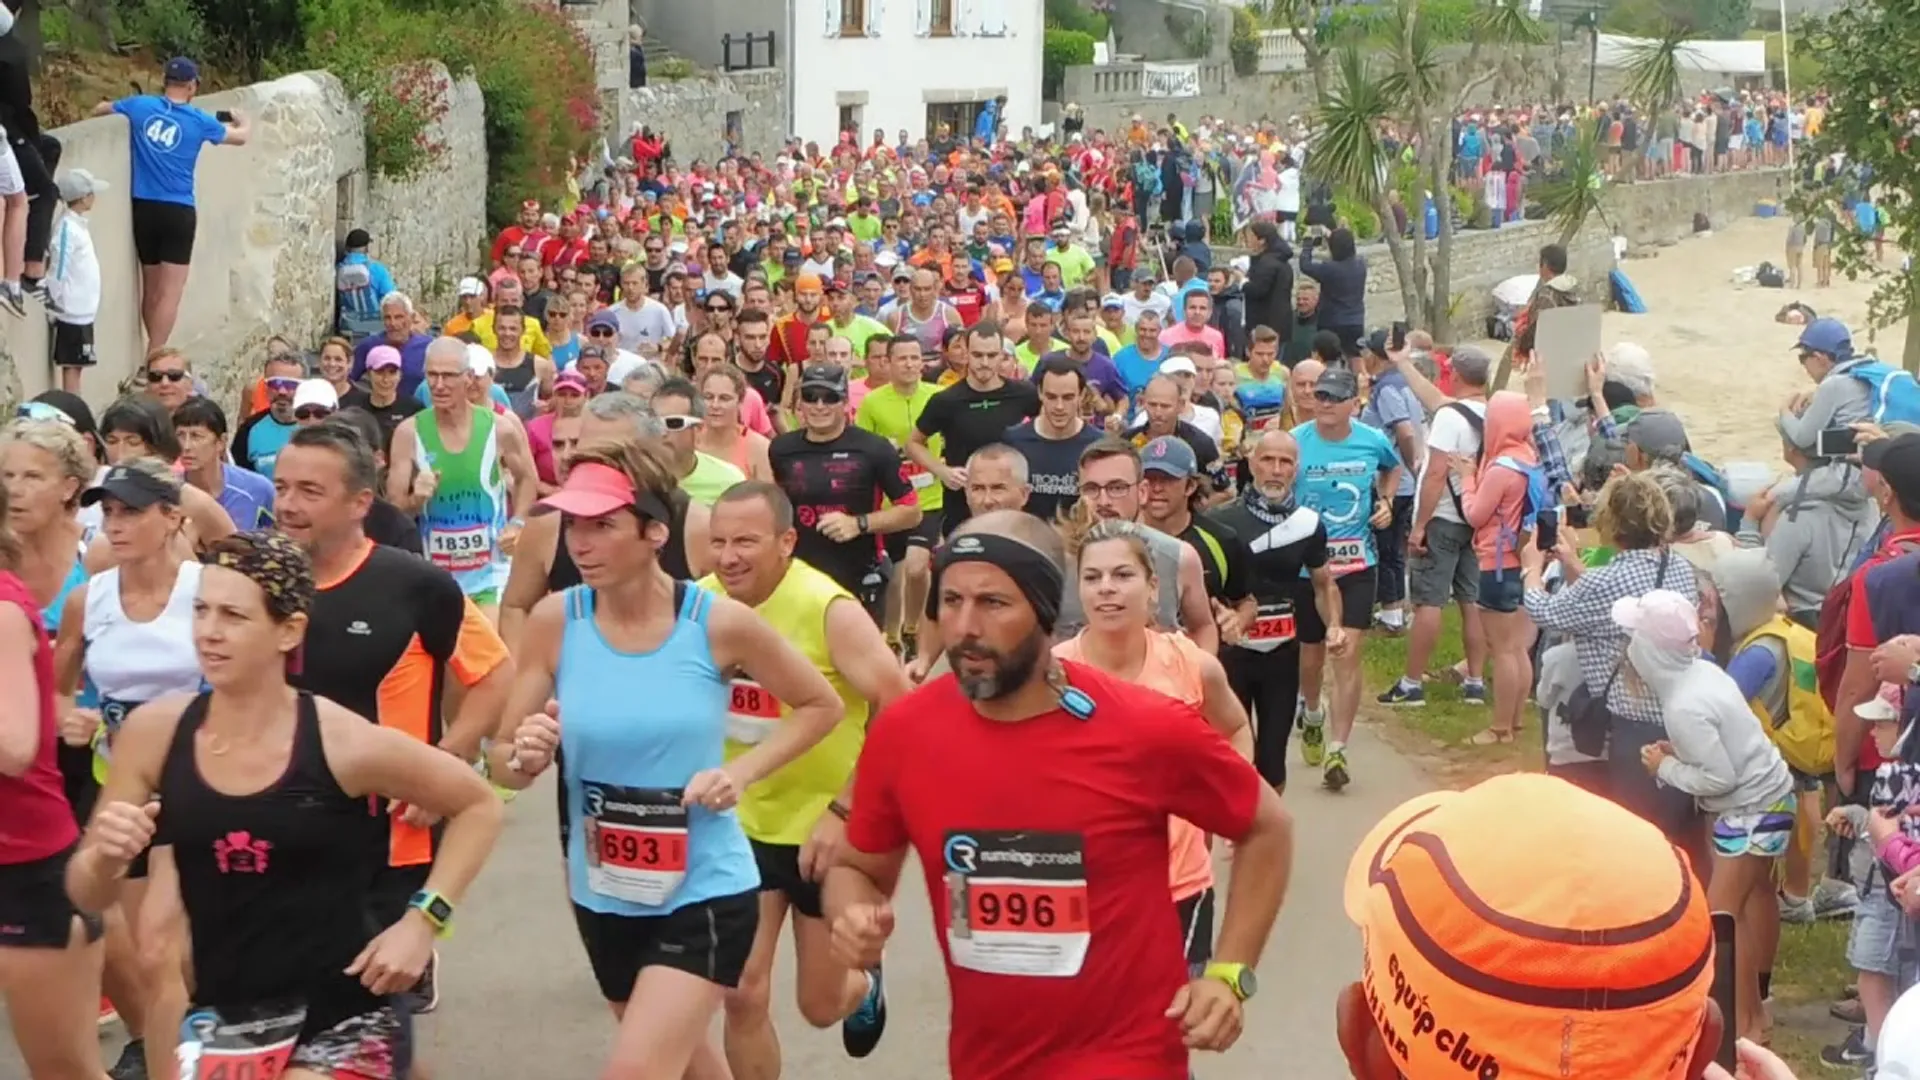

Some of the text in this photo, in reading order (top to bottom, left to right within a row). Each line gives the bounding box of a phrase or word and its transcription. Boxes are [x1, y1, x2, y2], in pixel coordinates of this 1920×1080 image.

[147, 120, 177, 147] 44
[434, 535, 482, 550] 1839
[604, 834, 659, 864] 693
[980, 850, 1082, 867] runningconseil
[978, 892, 1055, 927] 996
[1388, 952, 1499, 1080] equip club
